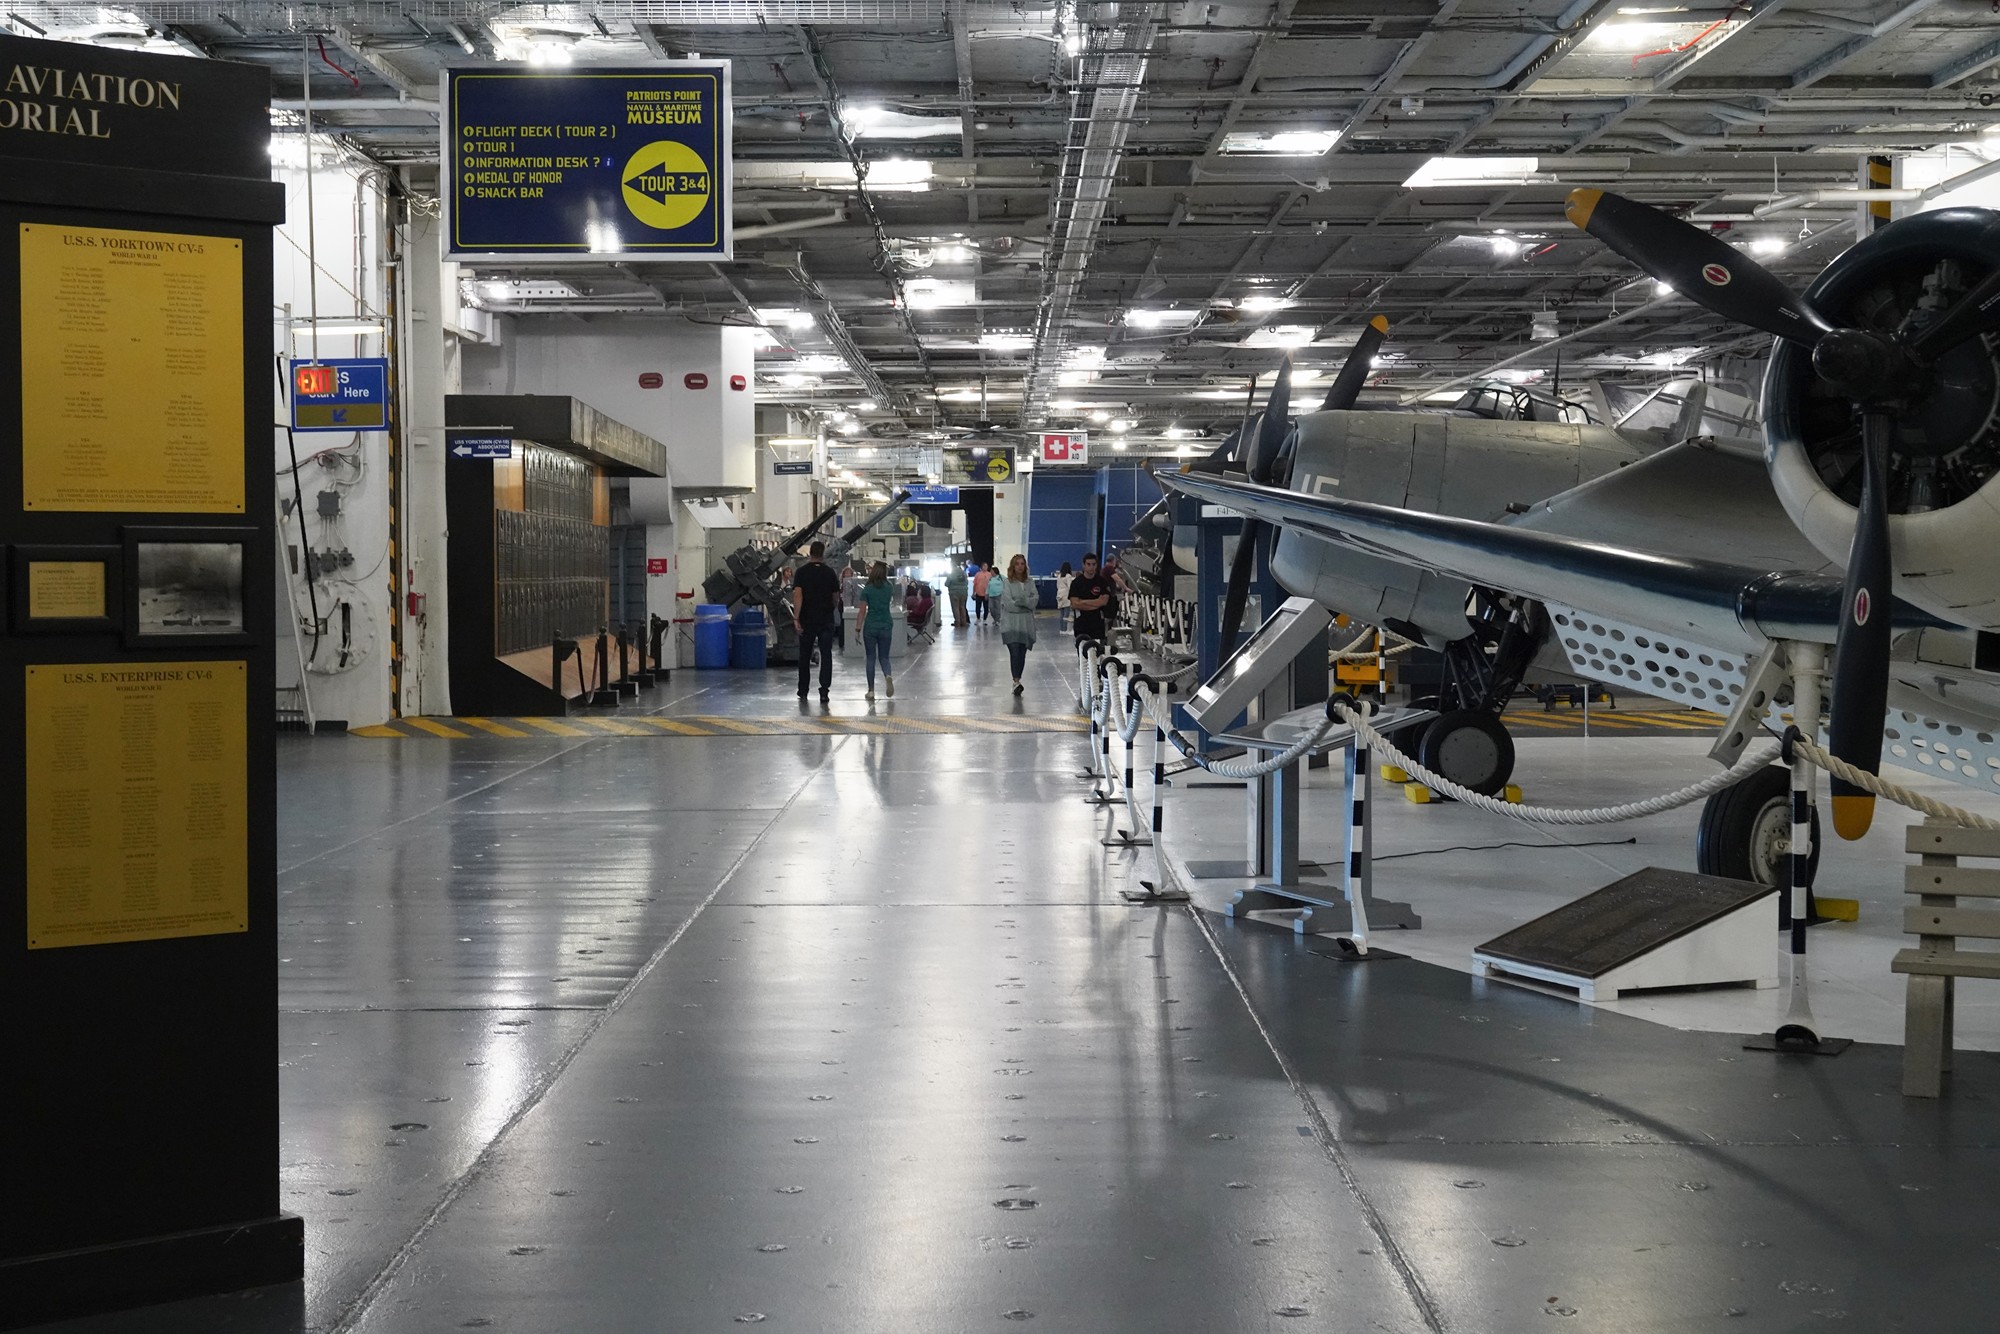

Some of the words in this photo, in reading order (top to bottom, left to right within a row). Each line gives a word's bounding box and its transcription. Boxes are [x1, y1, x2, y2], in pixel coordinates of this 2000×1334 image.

[5, 64, 181, 111] AVIATION
[626, 91, 671, 101] PATRIOTS
[674, 90, 702, 101] POINT
[627, 111, 702, 125] MUSEUM
[475, 126, 517, 137] FLIGHT
[520, 126, 552, 137] DECK
[476, 142, 507, 153] TOUR
[510, 142, 515, 153] 1
[475, 157, 552, 168] INFORMATION
[556, 157, 588, 168] DESK
[476, 172, 510, 183] MEDAL
[513, 172, 526, 183] OF
[529, 172, 562, 183] HONOR
[638, 176, 675, 192] TOUR
[679, 176, 707, 192] 3&4
[477, 187, 516, 198] SNACK
[520, 187, 544, 198] BAR
[63, 235, 97, 247] U.S.S.
[101, 237, 175, 252] YORKTOWN
[178, 244, 204, 254] CV-5
[111, 251, 135, 259] WORLD
[300, 369, 331, 393] EXIT
[344, 387, 369, 397] Here
[63, 673, 97, 684] U.S.S.
[101, 671, 183, 683] ENTERPRISE
[186, 670, 213, 681] CV-6
